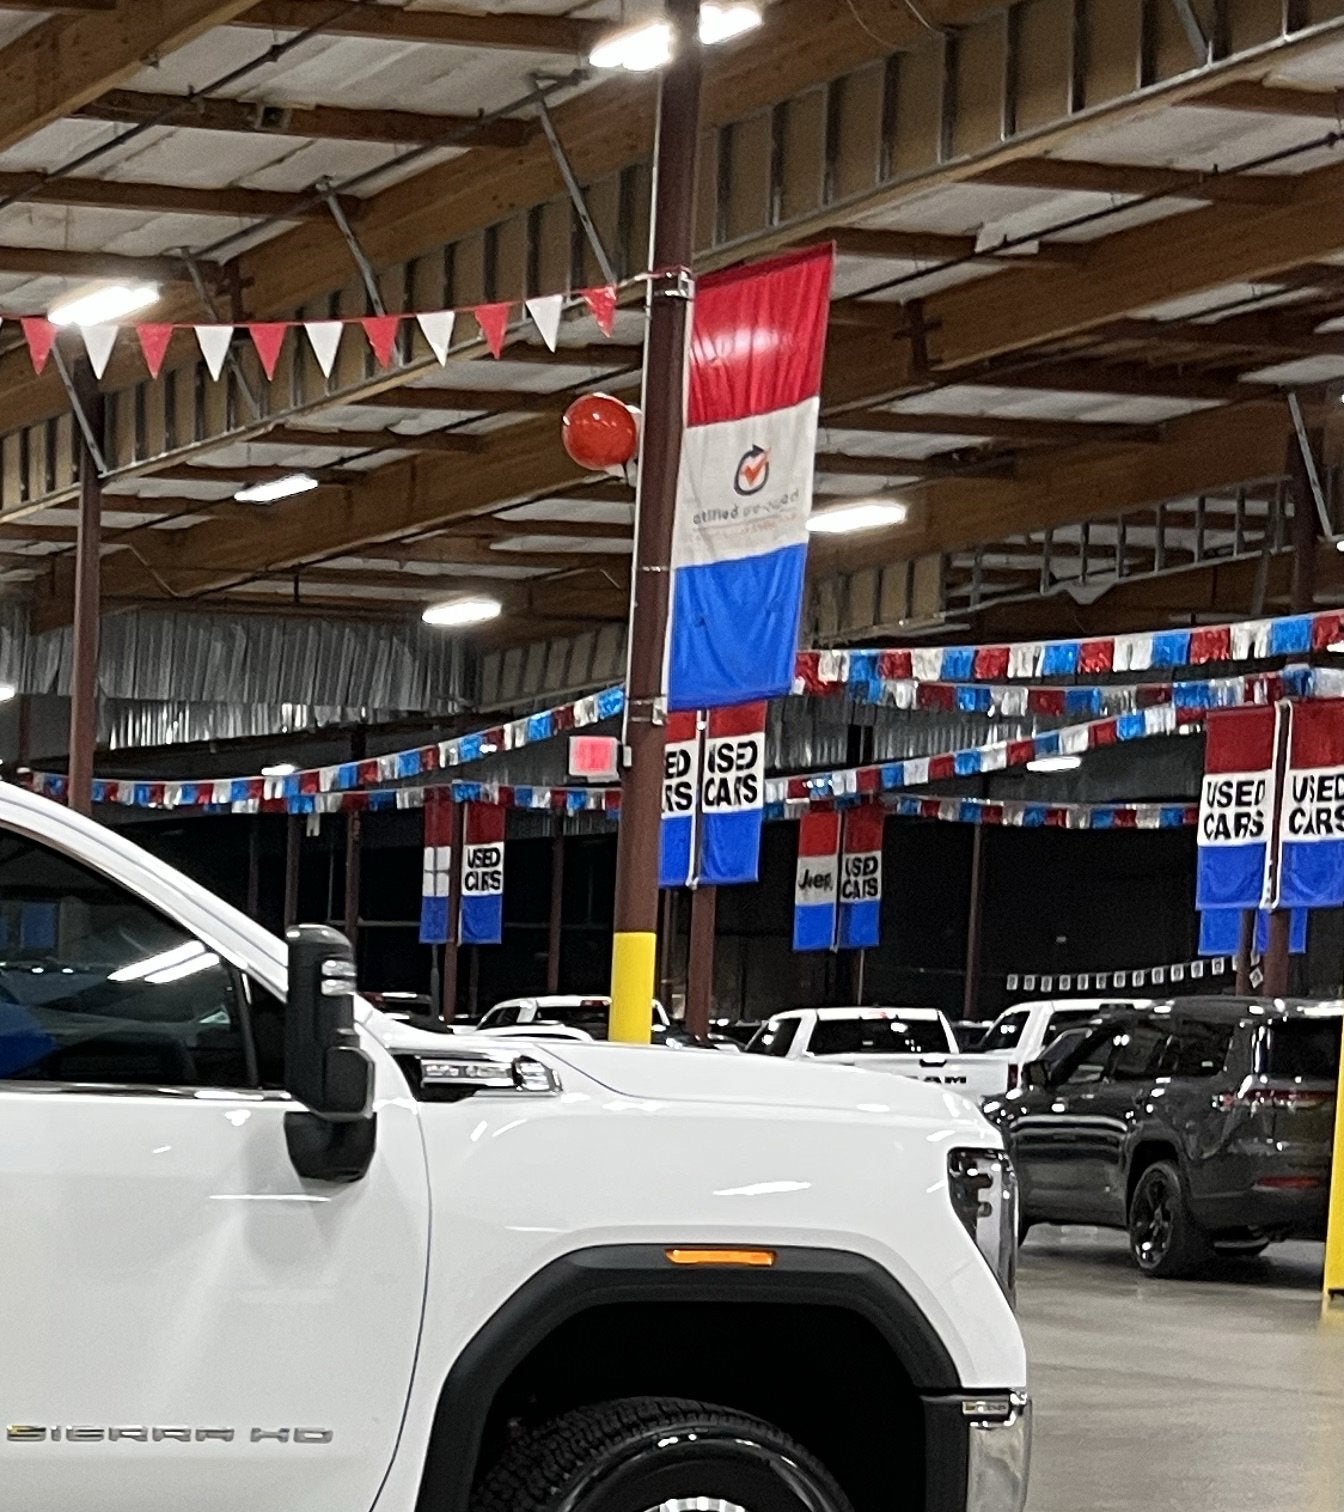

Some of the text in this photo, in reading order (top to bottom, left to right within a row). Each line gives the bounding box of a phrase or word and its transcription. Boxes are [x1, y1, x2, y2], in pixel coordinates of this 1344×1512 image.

[665, 749, 692, 779] ED
[1206, 779, 1266, 808] USED
[1203, 810, 1265, 840] CARS
[845, 856, 879, 878] USD
[905, 1075, 967, 1085] AM
[6, 1425, 333, 1444] SIERRA HD
